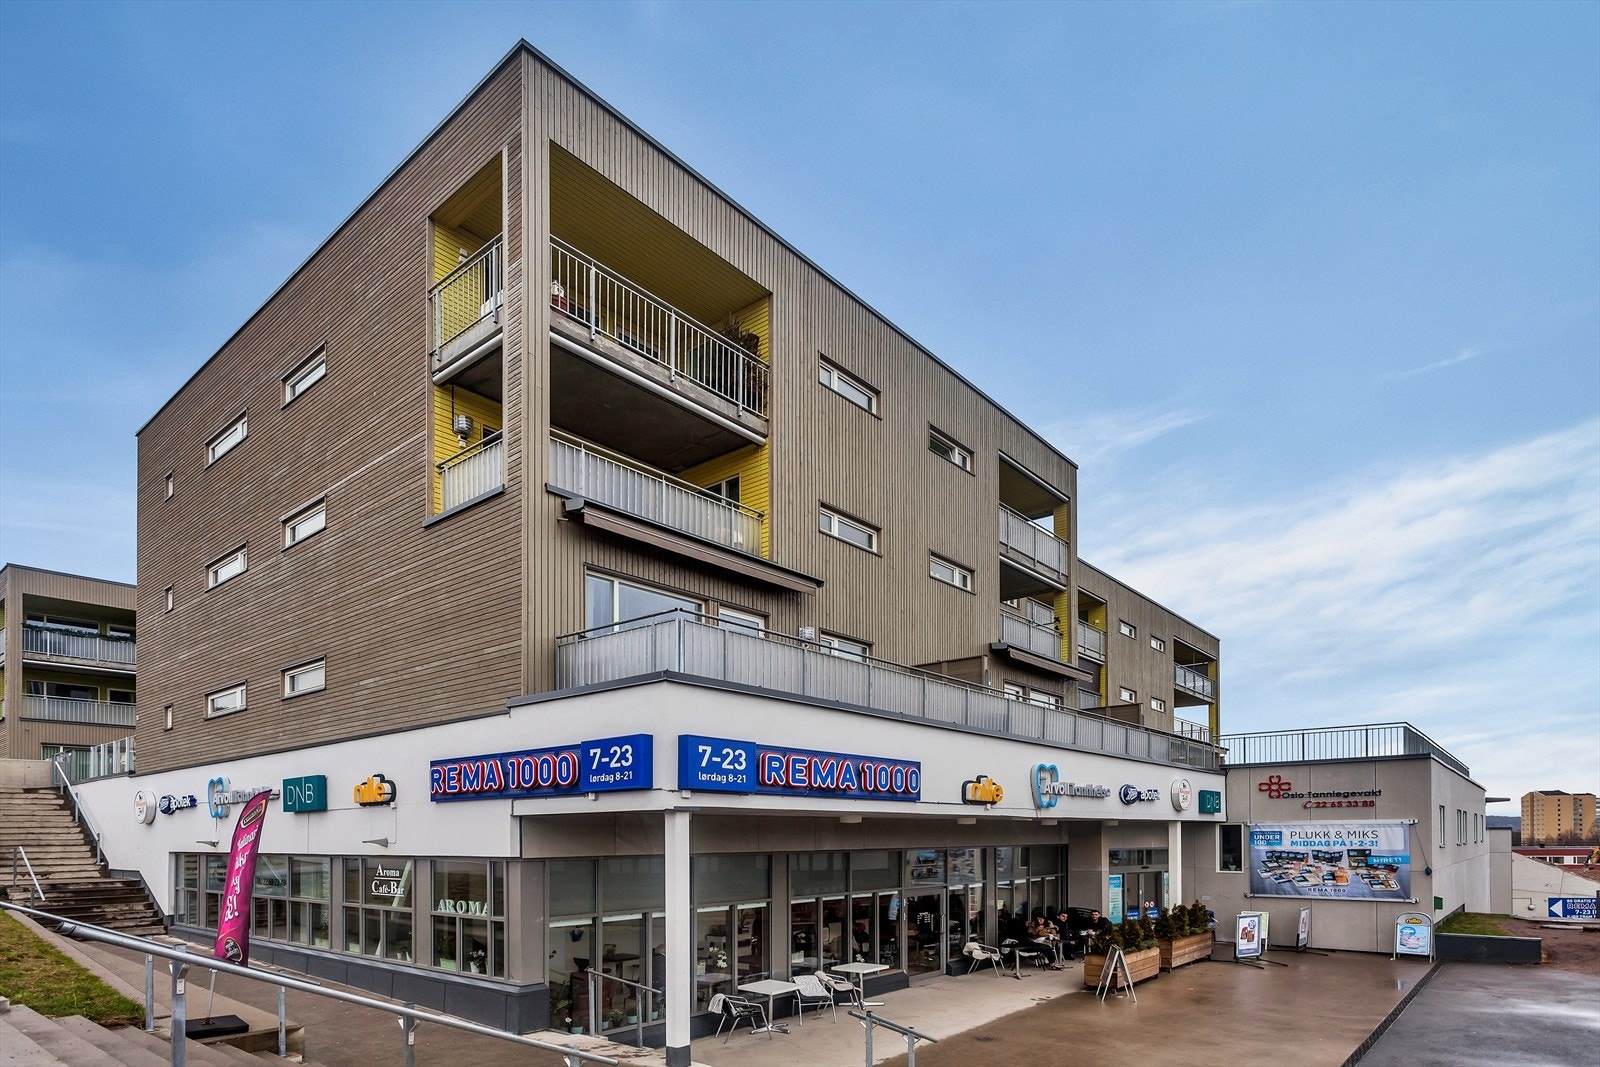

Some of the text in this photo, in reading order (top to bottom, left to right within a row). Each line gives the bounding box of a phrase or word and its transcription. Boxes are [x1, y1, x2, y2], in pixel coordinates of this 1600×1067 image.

[590, 744, 633, 769] 7-23
[698, 745, 746, 770] 7-23
[431, 752, 578, 794] REMA 1000
[590, 771, 632, 783] lørdag 8-21
[698, 771, 746, 784] lørdag 8-21
[762, 752, 920, 794] REMA 1000
[287, 777, 315, 811] DNB
[353, 777, 385, 803] nille
[1282, 790, 1382, 799] Oslo Tannlegevakt
[1347, 800, 1358, 808] 33
[1290, 830, 1331, 839] PLUKK
[1334, 830, 1343, 839] &
[1347, 830, 1379, 839] MIKS
[1333, 839, 1347, 847] PÅ
[376, 864, 399, 876] Aroma
[371, 880, 405, 895] Café-Bar
